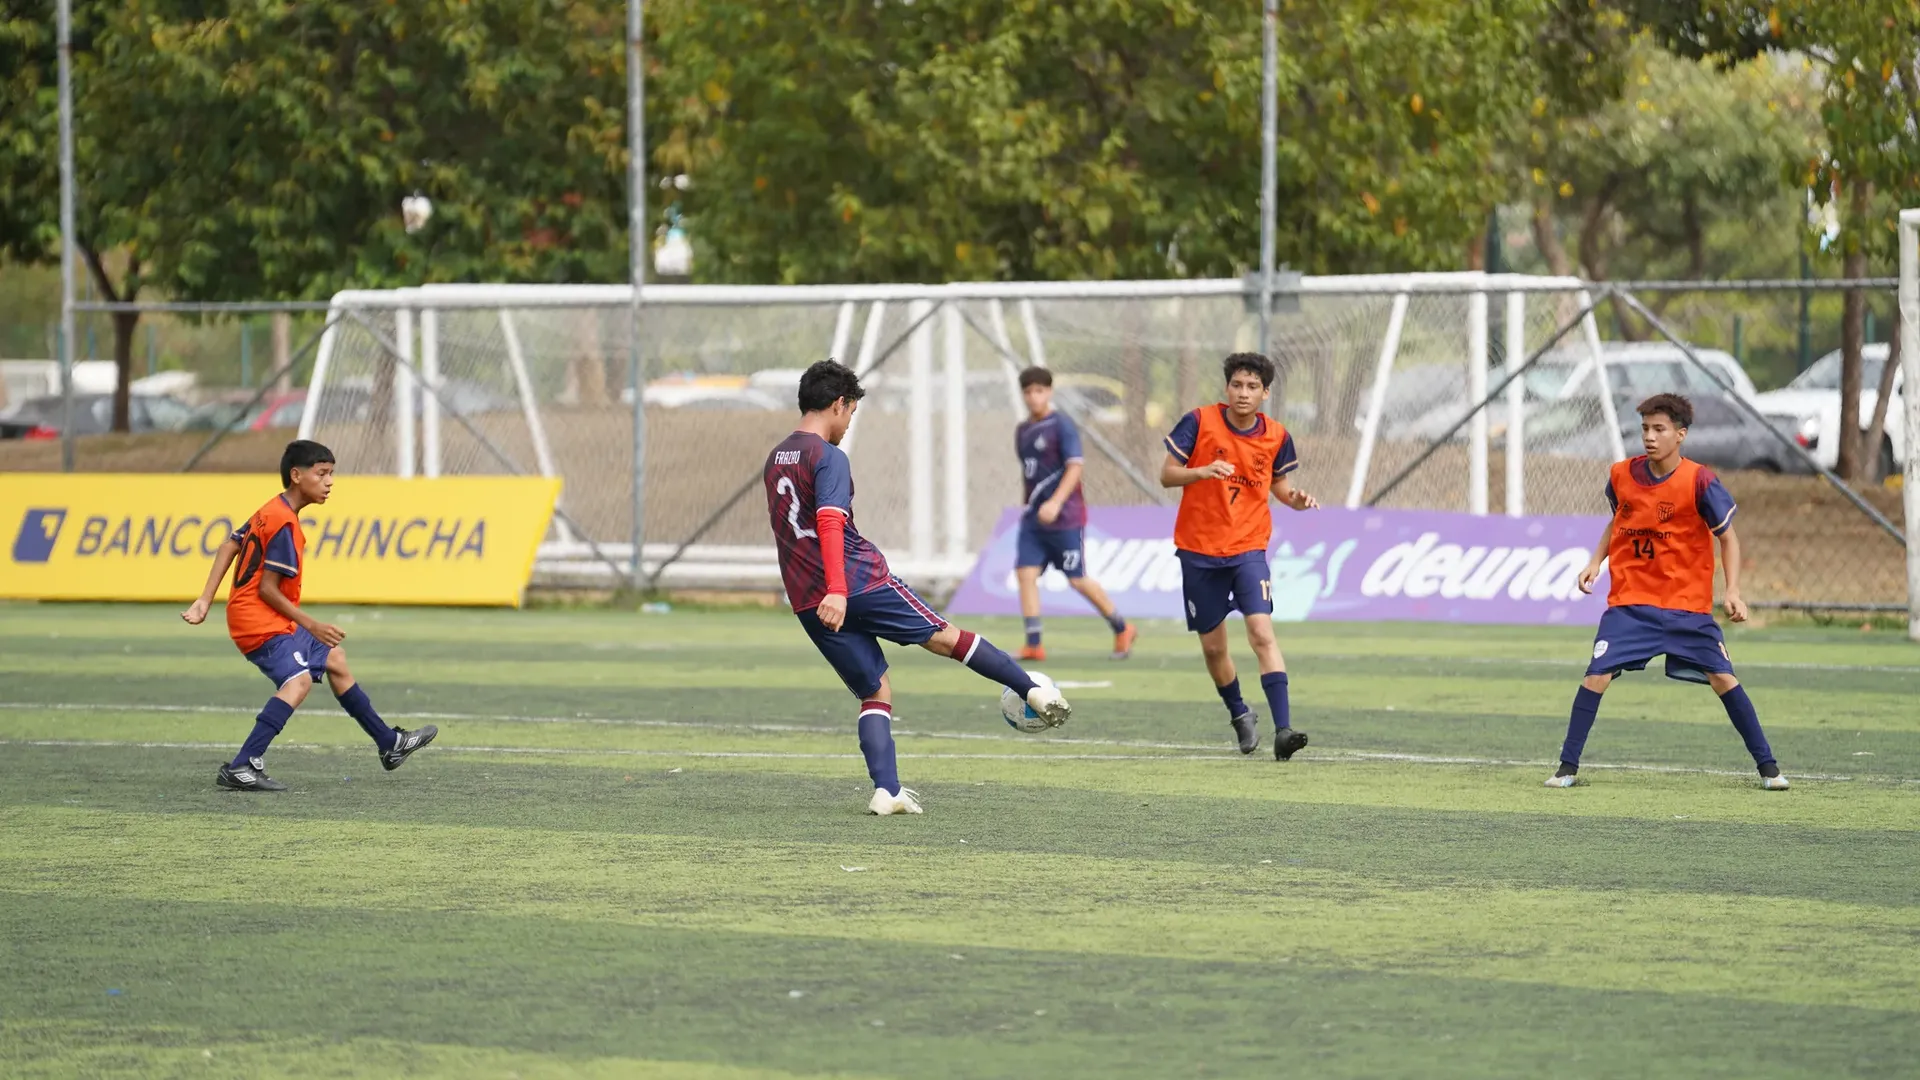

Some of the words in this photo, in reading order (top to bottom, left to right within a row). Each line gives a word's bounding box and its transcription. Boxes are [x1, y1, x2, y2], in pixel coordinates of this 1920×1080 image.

[1228, 486, 1240, 505] 7
[777, 476, 818, 539] 2
[75, 515, 234, 557] BANCO
[300, 516, 487, 560] HINCHA
[1632, 538, 1655, 559] 14
[1063, 550, 1080, 571] 27
